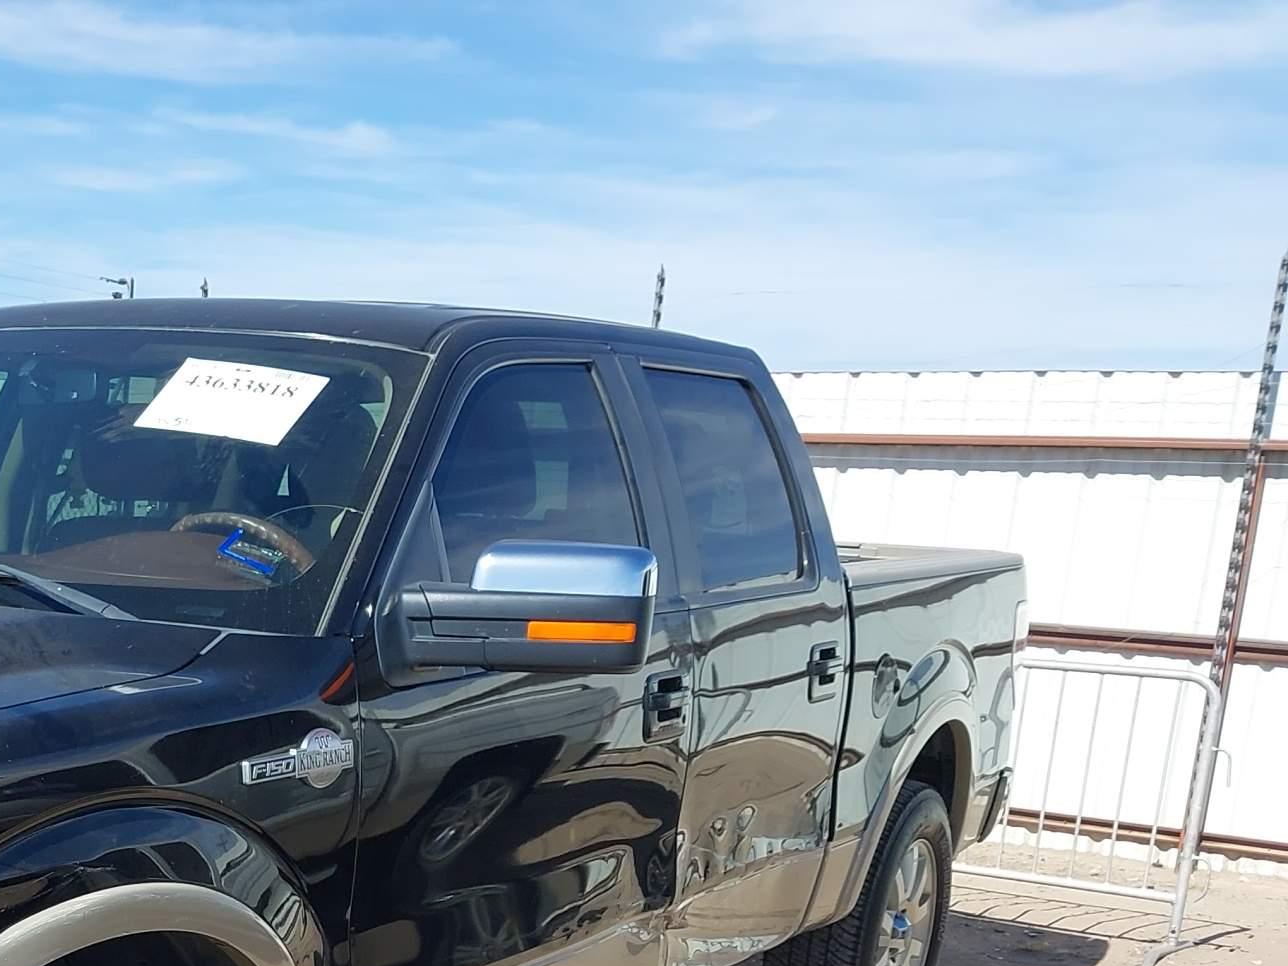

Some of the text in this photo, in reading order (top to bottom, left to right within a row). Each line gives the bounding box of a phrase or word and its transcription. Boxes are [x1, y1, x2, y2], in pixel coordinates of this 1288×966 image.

[184, 374, 300, 399] 43633818
[298, 751, 321, 772] KING
[323, 744, 352, 767] RANCH
